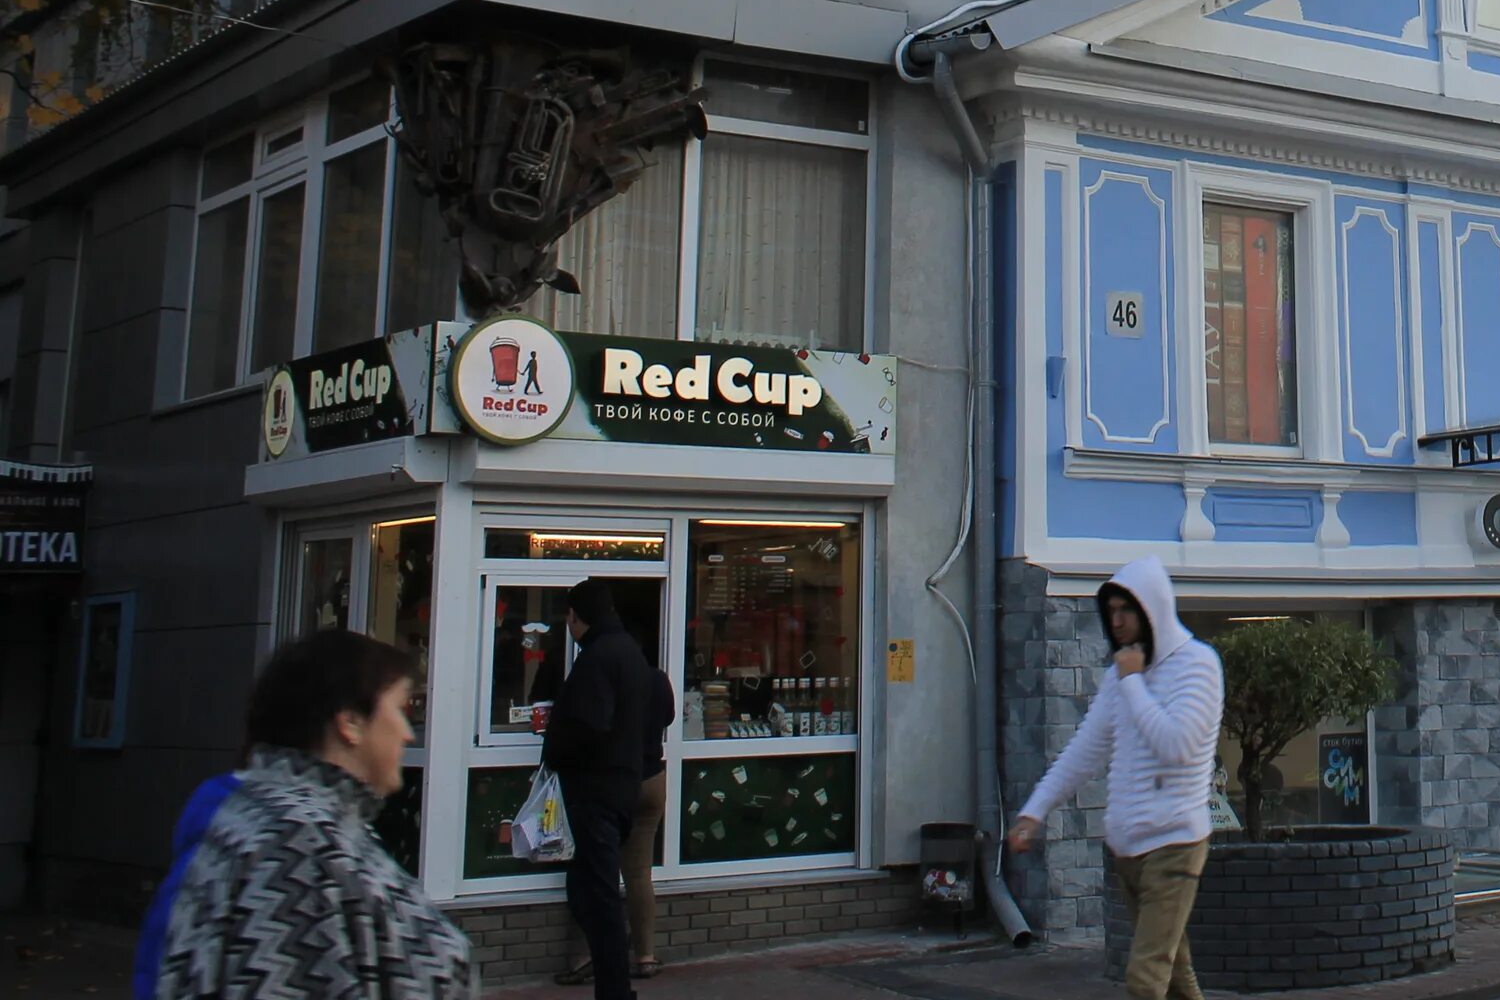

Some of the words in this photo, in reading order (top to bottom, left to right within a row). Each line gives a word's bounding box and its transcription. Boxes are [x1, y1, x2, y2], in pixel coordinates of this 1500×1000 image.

[1112, 299, 1138, 329] 46
[308, 361, 348, 410] Red
[350, 358, 391, 404] Cup
[603, 348, 711, 400] Red
[717, 357, 822, 416] Cup
[483, 397, 514, 411] Red
[516, 399, 548, 416] Cup
[595, 404, 642, 420] ТВОЙ
[649, 407, 695, 423] КОФЕ
[702, 410, 711, 425] С
[717, 411, 775, 427] СОБОЙ
